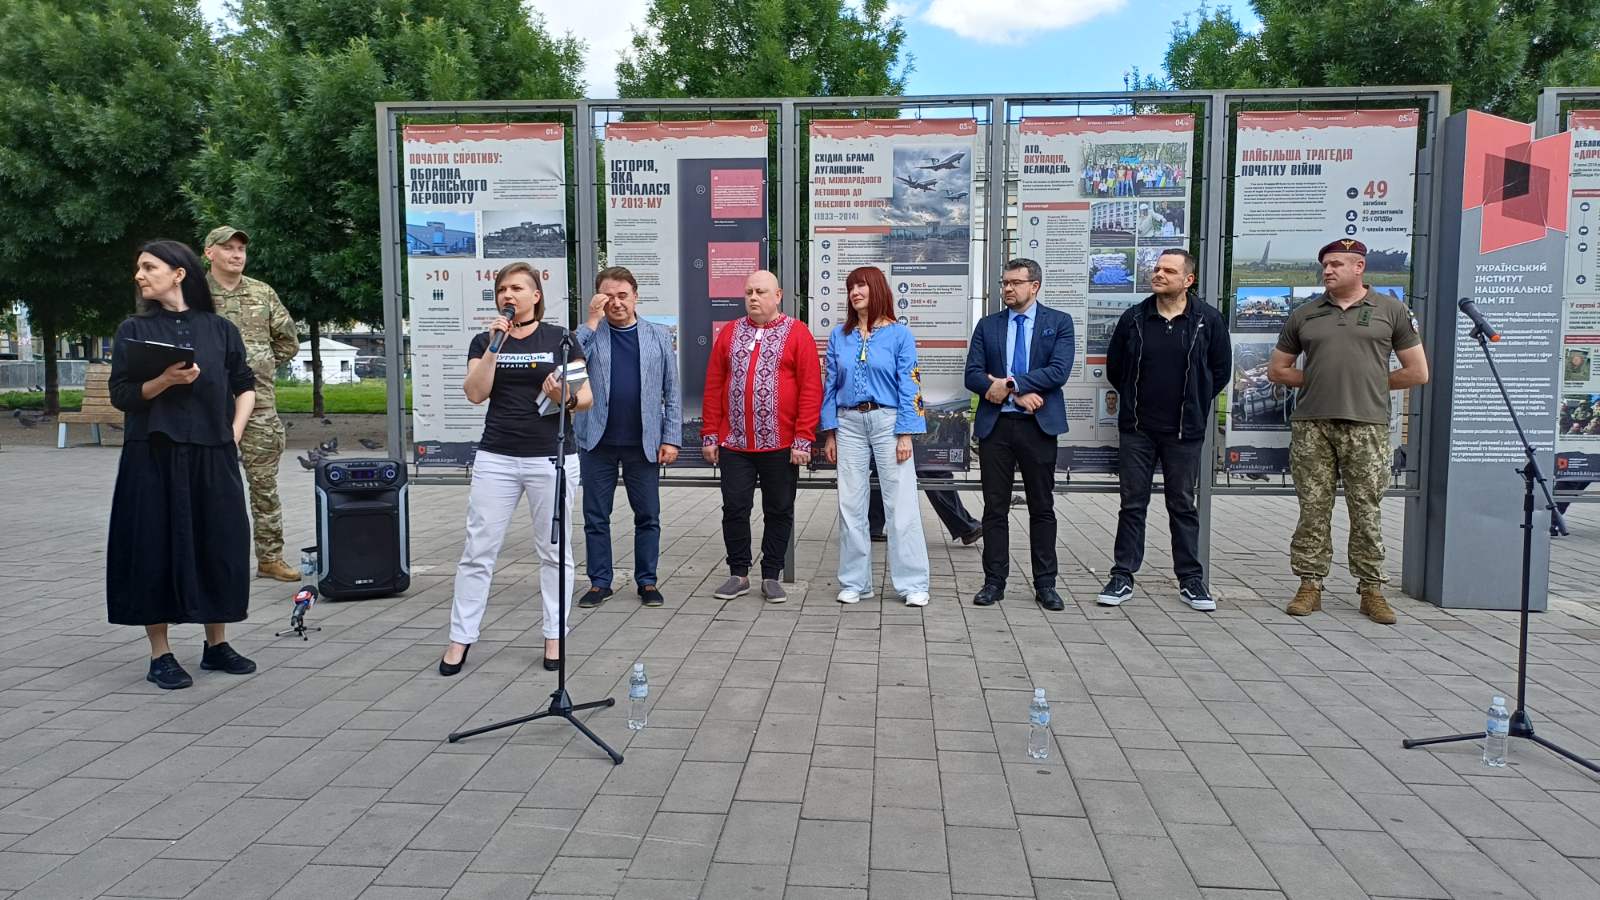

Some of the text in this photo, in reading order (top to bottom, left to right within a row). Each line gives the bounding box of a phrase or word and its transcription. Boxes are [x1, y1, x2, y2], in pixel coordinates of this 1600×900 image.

[1024, 145, 1042, 154] АТО,
[1242, 148, 1353, 162] НАЙБІЛЬША ТРАГЕДІЯ
[409, 152, 503, 164] ПОЧАТОК СПРОТИВУ:
[814, 152, 874, 163] СХІДНА БРАМА
[1024, 154, 1066, 165] ОКУПАЦІЯ,
[611, 159, 658, 173] ІСТОРІЯ,
[814, 165, 865, 175] ЛУГАНЩИНИ:
[1024, 164, 1071, 175] ВЕЛИКДЕНЬ
[1241, 163, 1322, 177] ПОЧАТКУ ВІЙНИ
[410, 168, 461, 180] ОБОРОНА
[611, 172, 633, 183] ЯКА
[411, 179, 488, 192] ЛУГАНСЬКОГО
[828, 176, 882, 185] МІЖНАРОДНОГО
[611, 183, 671, 196] ПОЧАЛАСЯ
[1363, 180, 1388, 199] 49
[411, 192, 474, 204] АЕРОПОРТУ
[611, 197, 662, 208] У 2013-МУ
[1475, 262, 1547, 272] УКРАЇНСЬКИЙ
[1475, 275, 1523, 283] ІНСТИТУТ
[1474, 284, 1553, 294] НАЦІОНАЛЬНОЇ
[1474, 297, 1515, 305] ПАМ'ЯТІ
